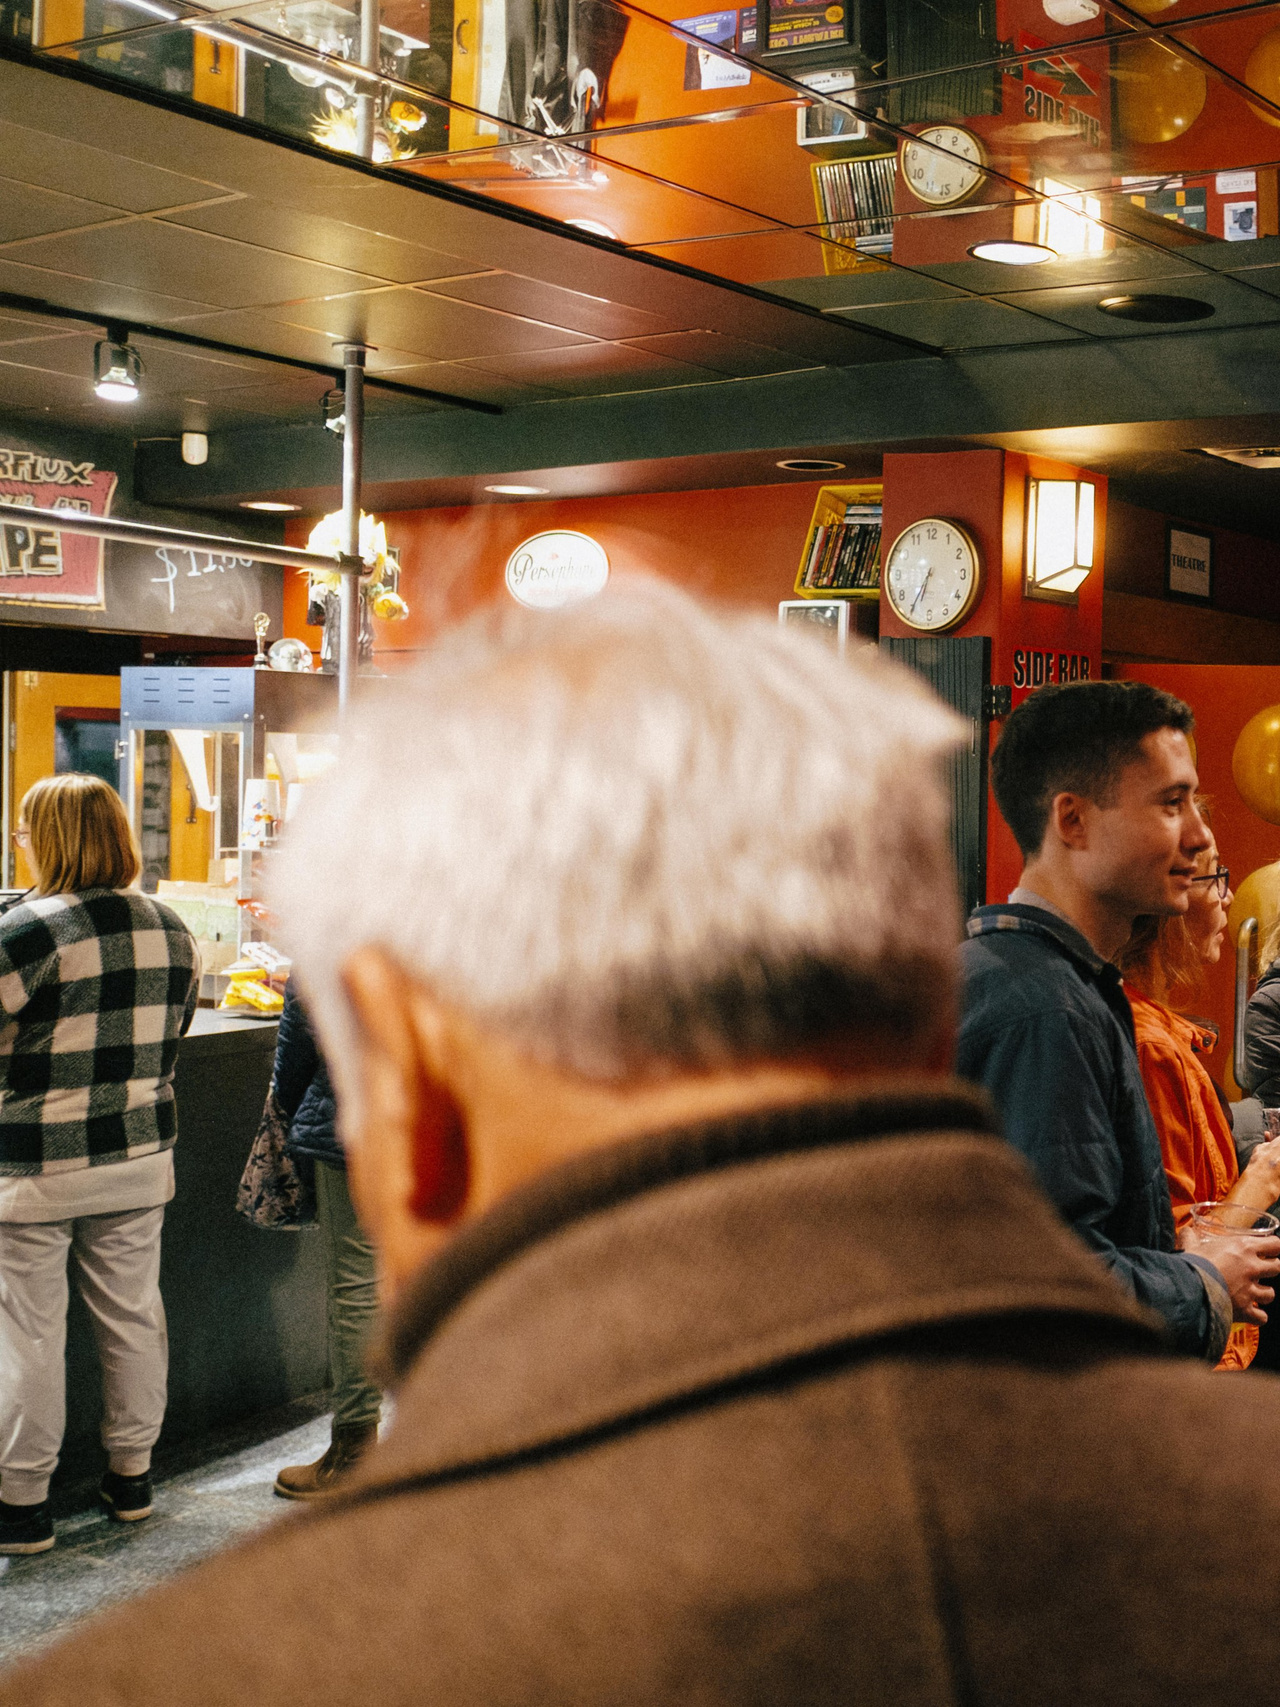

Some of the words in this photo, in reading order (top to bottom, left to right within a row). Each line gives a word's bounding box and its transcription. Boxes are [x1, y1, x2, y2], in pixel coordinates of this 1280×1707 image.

[911, 533, 921, 546] 11
[926, 527, 938, 540] 12
[945, 533, 951, 545] 1
[0, 522, 63, 576] PE
[955, 547, 963, 560] 2
[1171, 553, 1206, 573] THEATRE
[513, 553, 600, 588] Persephon
[895, 569, 902, 581] 9
[959, 568, 967, 580] 3
[898, 589, 906, 601] 8
[954, 588, 961, 601] 4
[926, 609, 933, 622] 6
[942, 603, 949, 616] 5
[1013, 649, 1056, 689] SIDE
[1058, 653, 1092, 684] BAR
